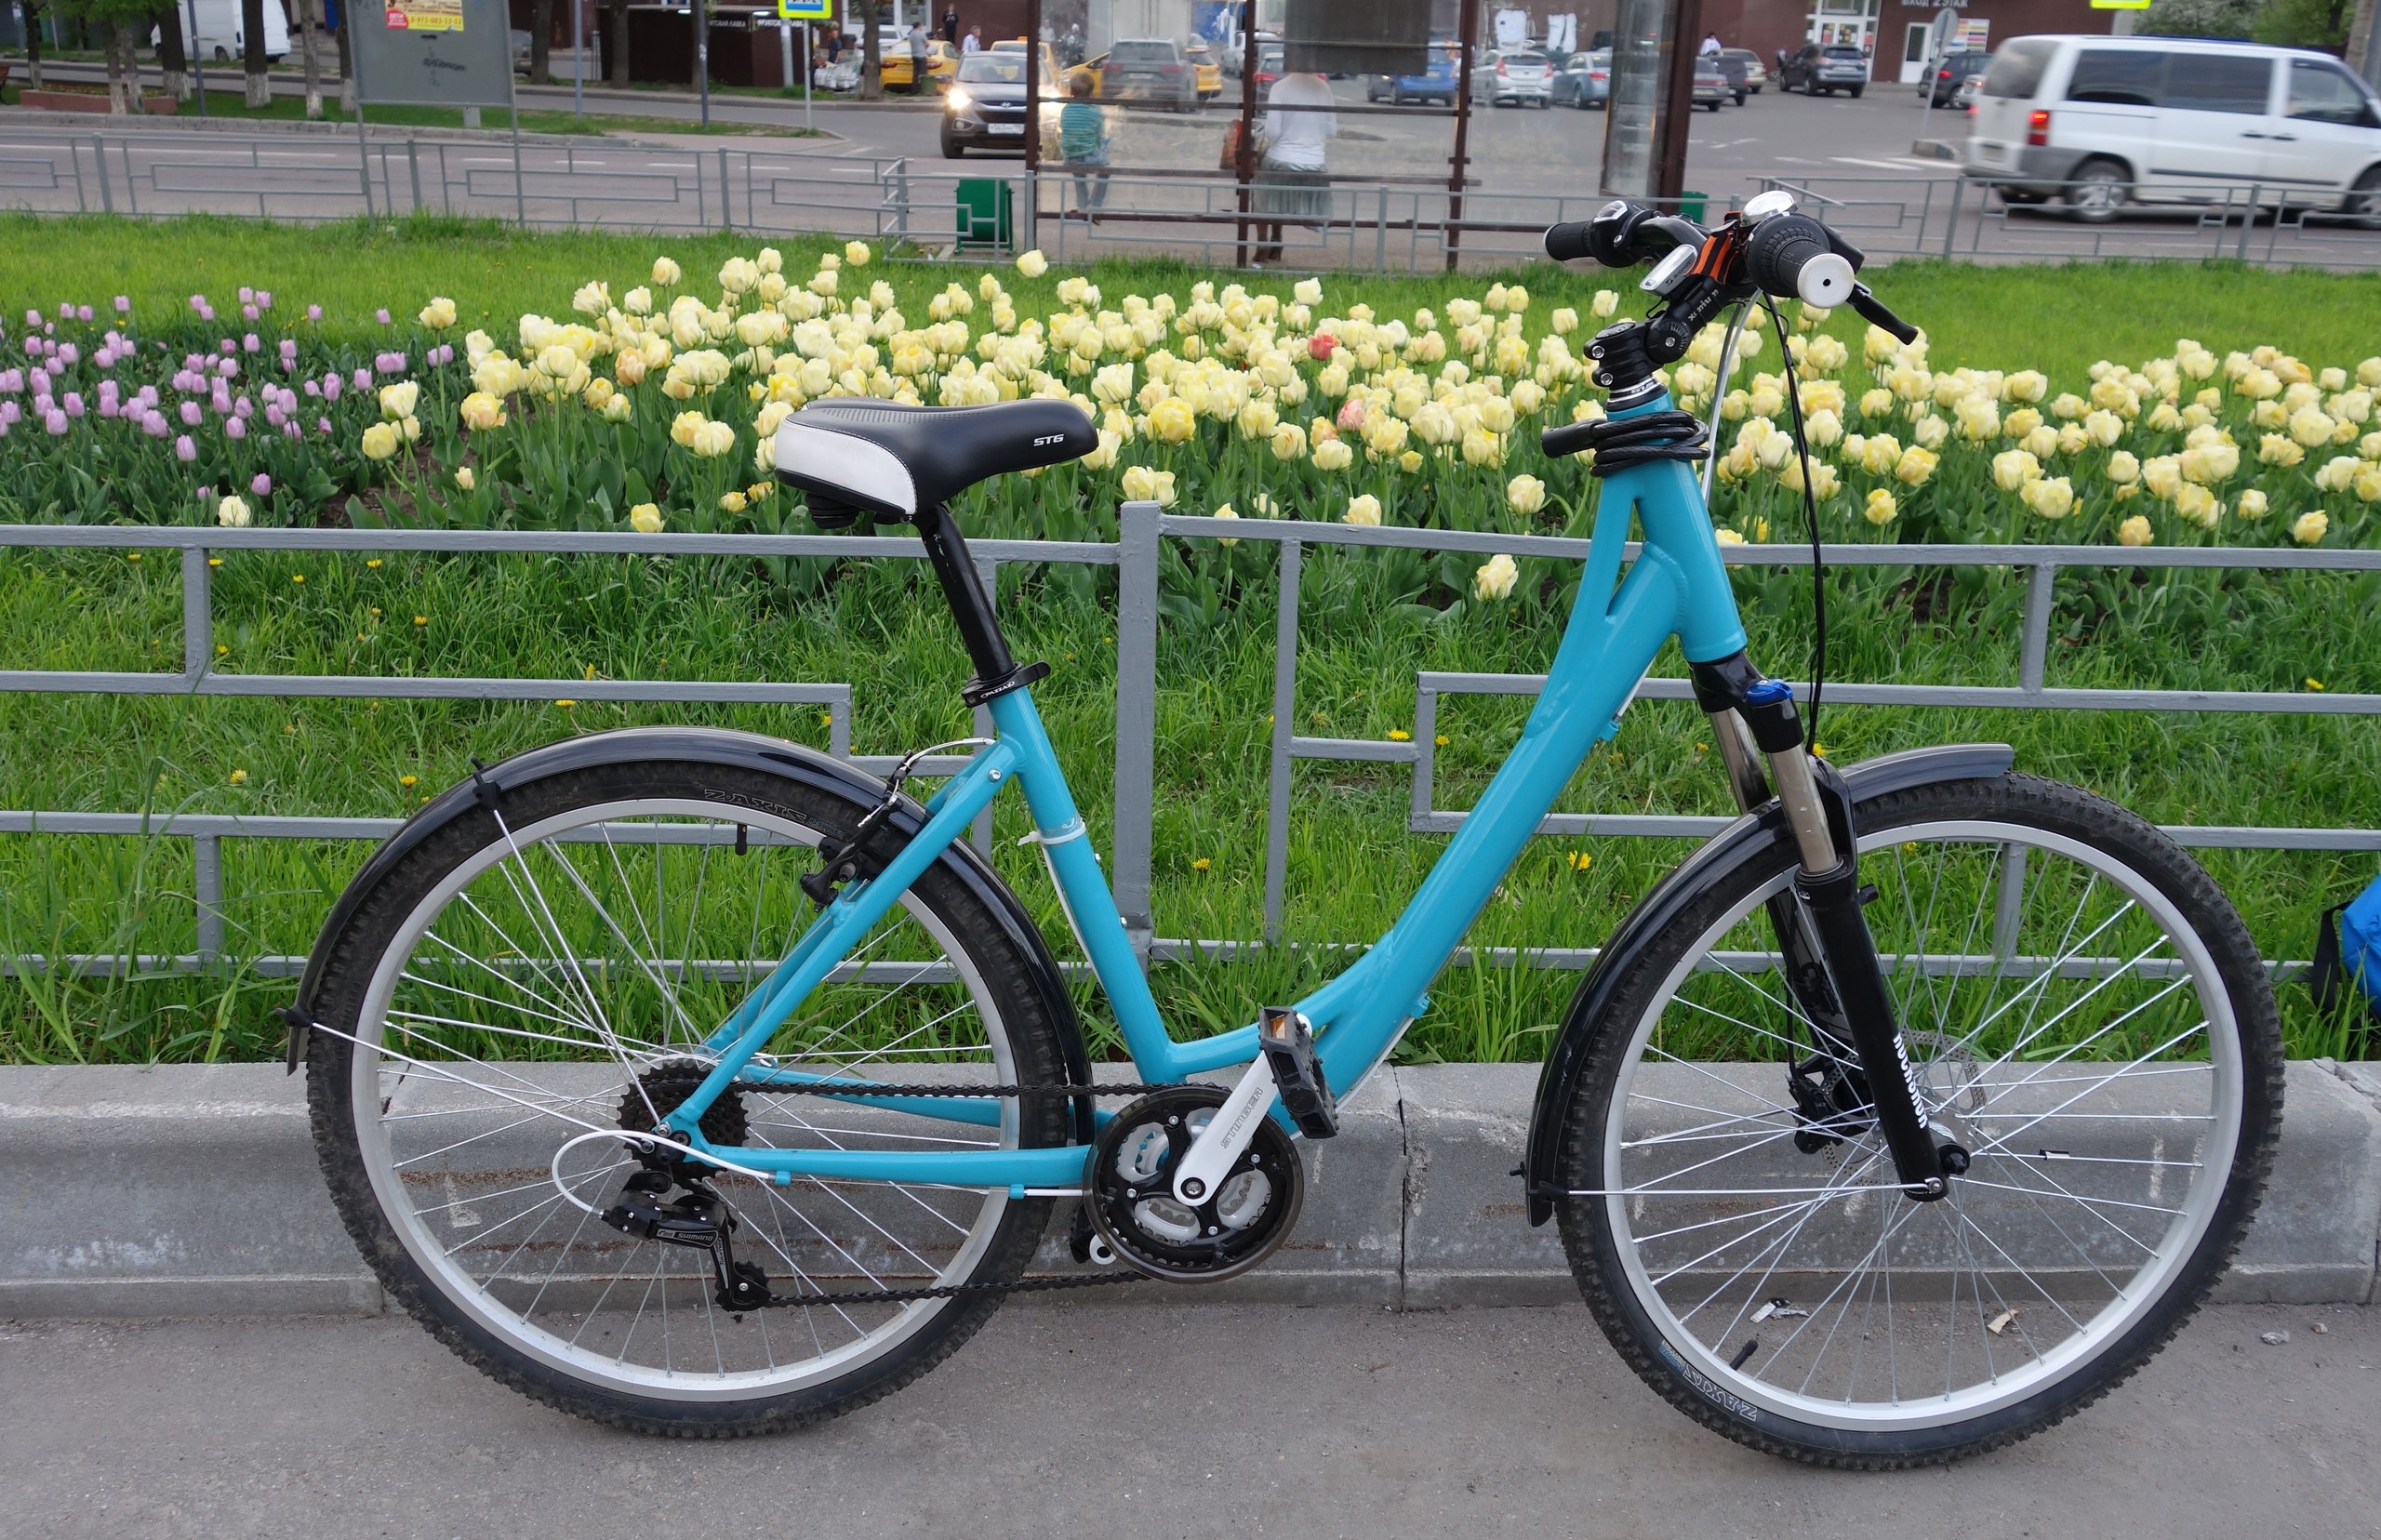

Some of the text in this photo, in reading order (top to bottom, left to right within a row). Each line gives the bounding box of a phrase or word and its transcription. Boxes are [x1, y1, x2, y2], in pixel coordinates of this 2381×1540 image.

[1033, 433, 1065, 446] STG
[1220, 1087, 1264, 1149] STINGER
[678, 1232, 713, 1241] SHIMANO
